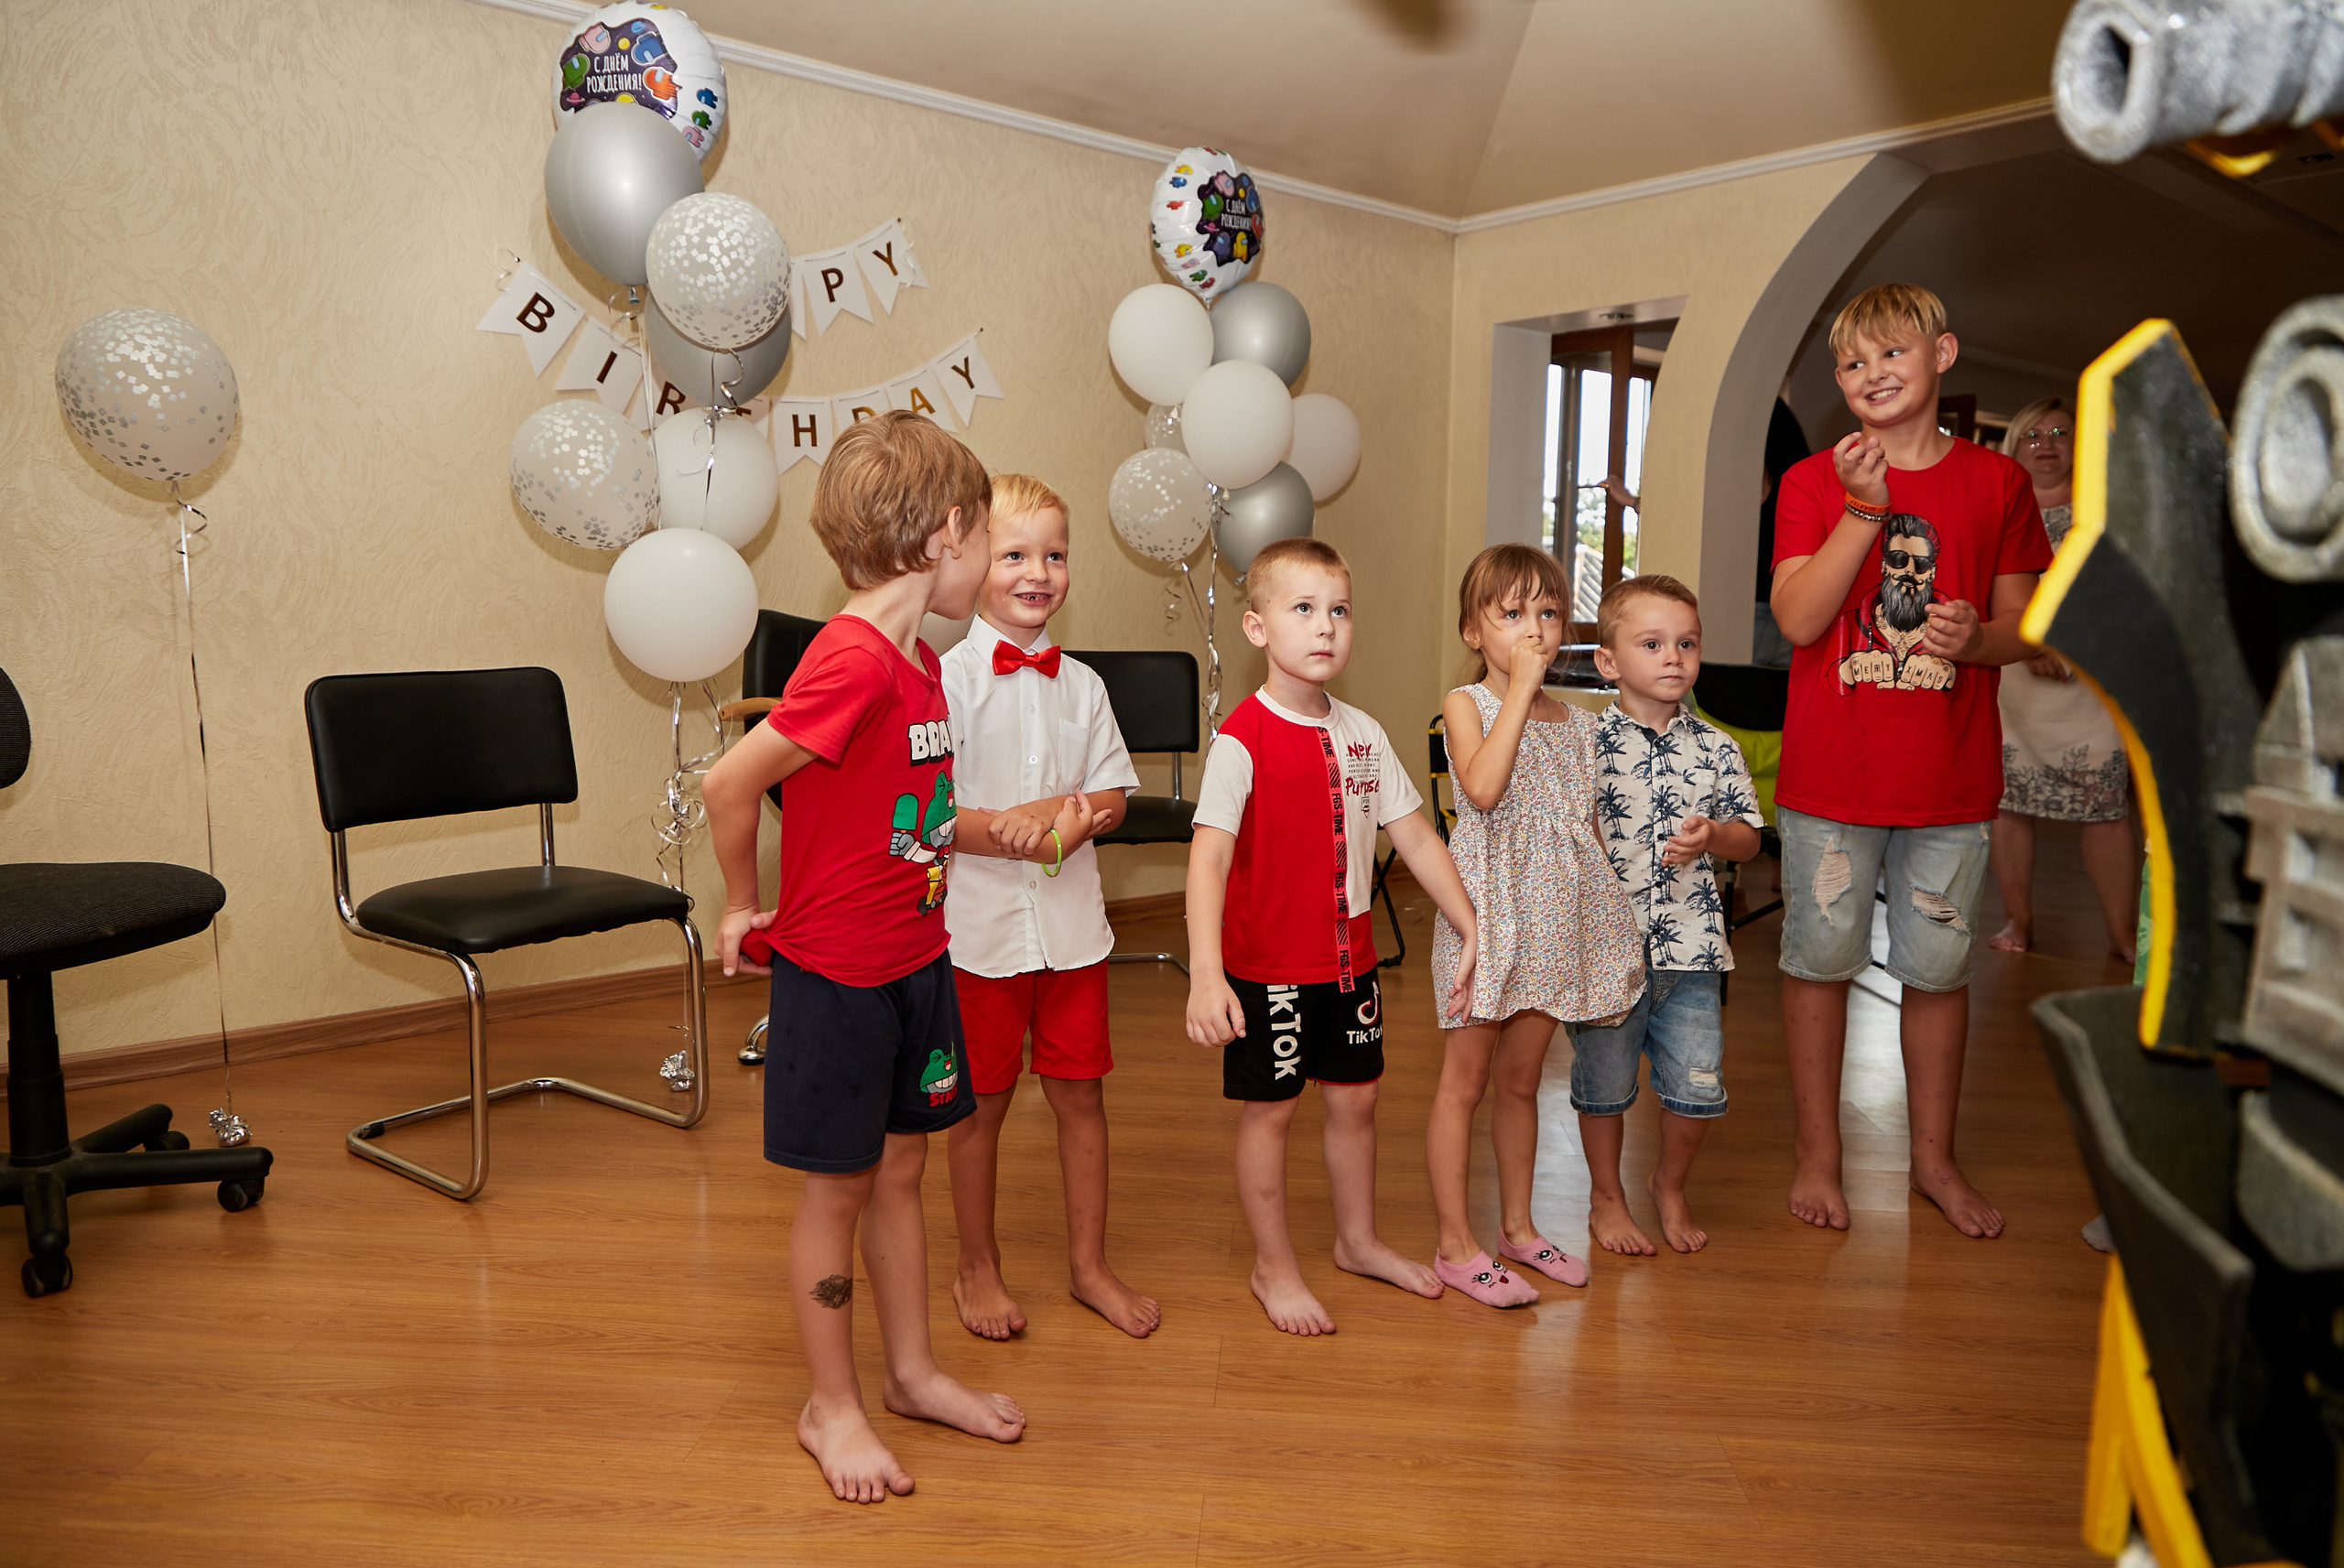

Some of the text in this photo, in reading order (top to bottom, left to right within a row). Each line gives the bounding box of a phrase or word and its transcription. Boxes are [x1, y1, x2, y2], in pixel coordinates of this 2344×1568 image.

[593, 52, 629, 73] С ДНЁМ
[586, 73, 642, 93] РОЖДЕНИЯ!
[1331, 793, 1344, 836] FGS-TIME
[1335, 871, 1348, 914] FGS-TIME
